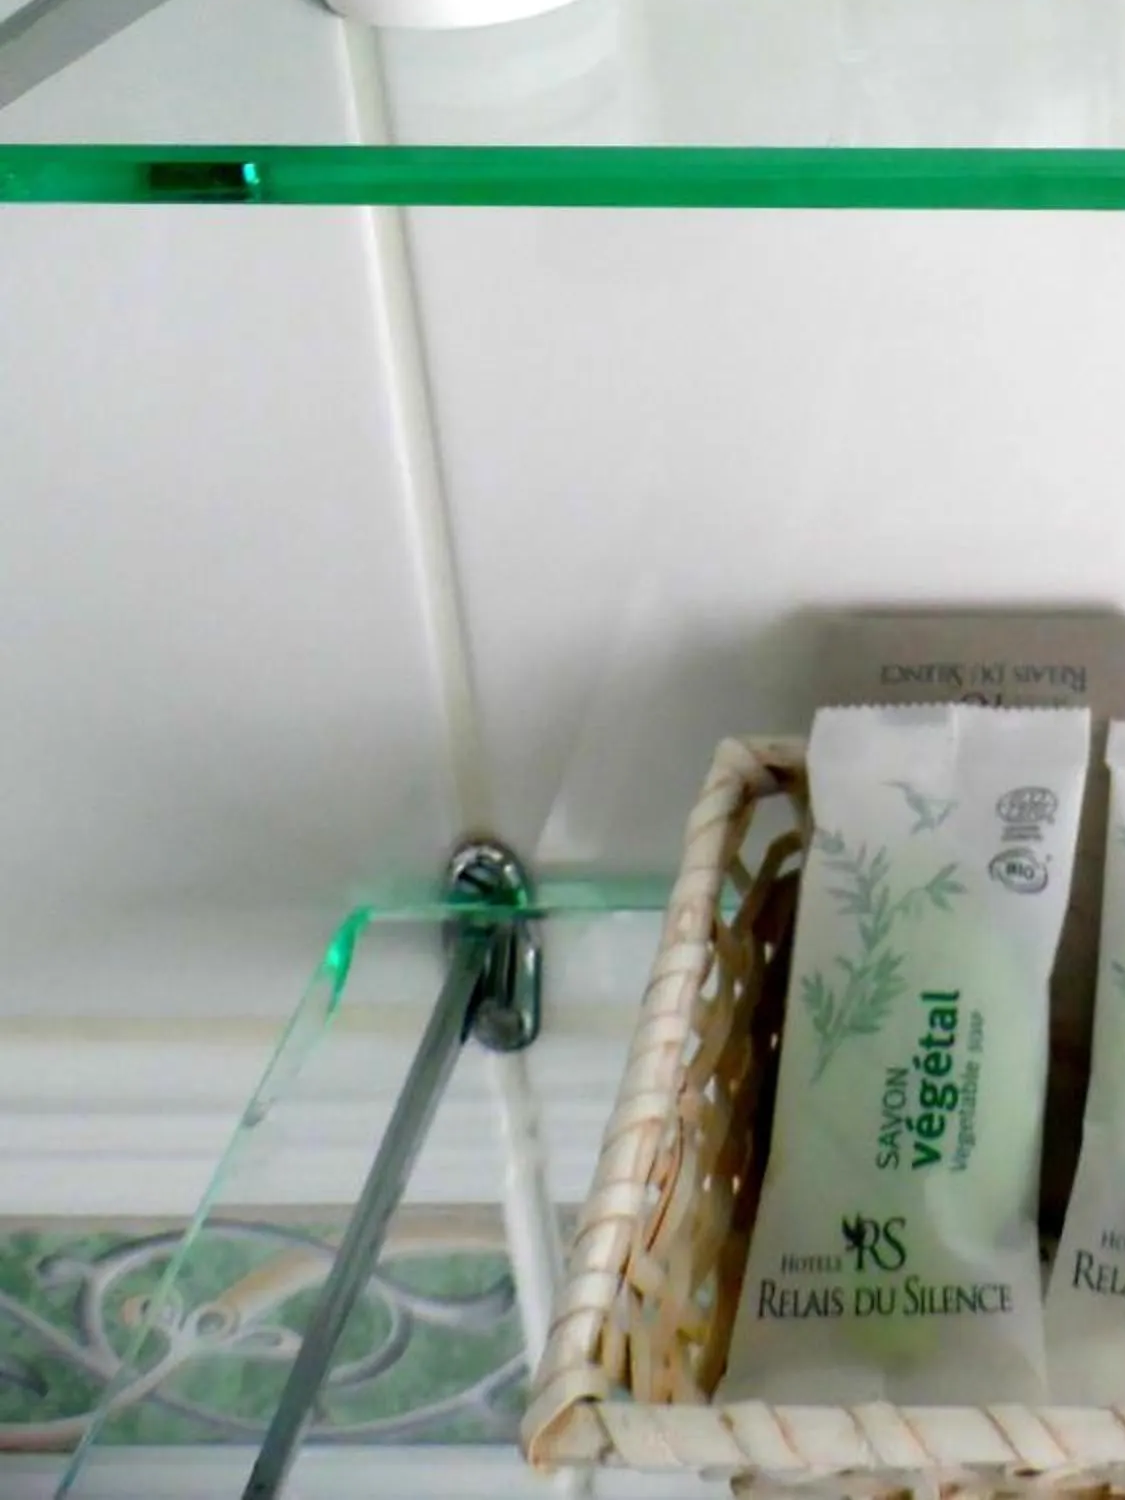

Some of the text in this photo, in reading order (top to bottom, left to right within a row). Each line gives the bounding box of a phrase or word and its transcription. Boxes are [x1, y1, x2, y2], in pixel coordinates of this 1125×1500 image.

[875, 1068, 909, 1171] SAVON
[905, 989, 960, 1171] végétal
[758, 1274, 1014, 1319] RELAIS DU SILENCE
